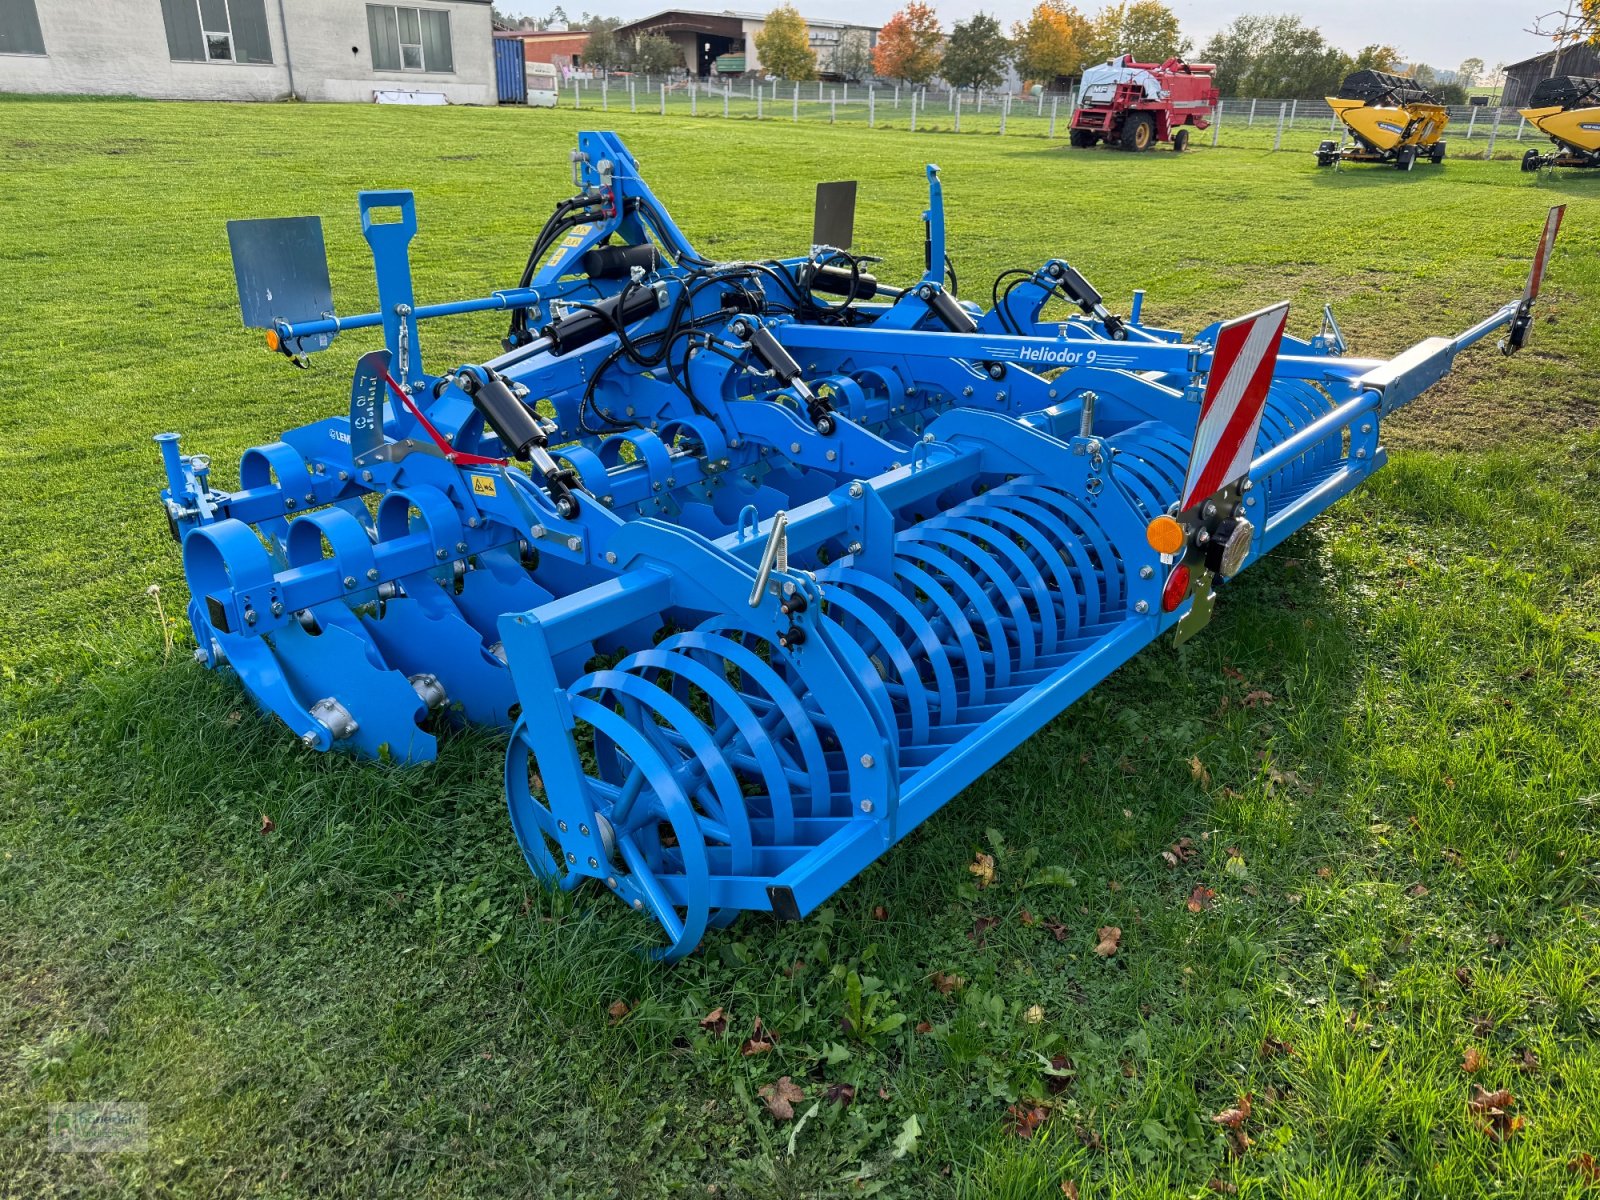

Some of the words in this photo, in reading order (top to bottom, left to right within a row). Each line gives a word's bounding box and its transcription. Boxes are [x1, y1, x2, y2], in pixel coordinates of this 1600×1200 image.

[1093, 85, 1108, 93] MF
[1020, 345, 1083, 363] Heliodor
[1086, 350, 1097, 364] 9
